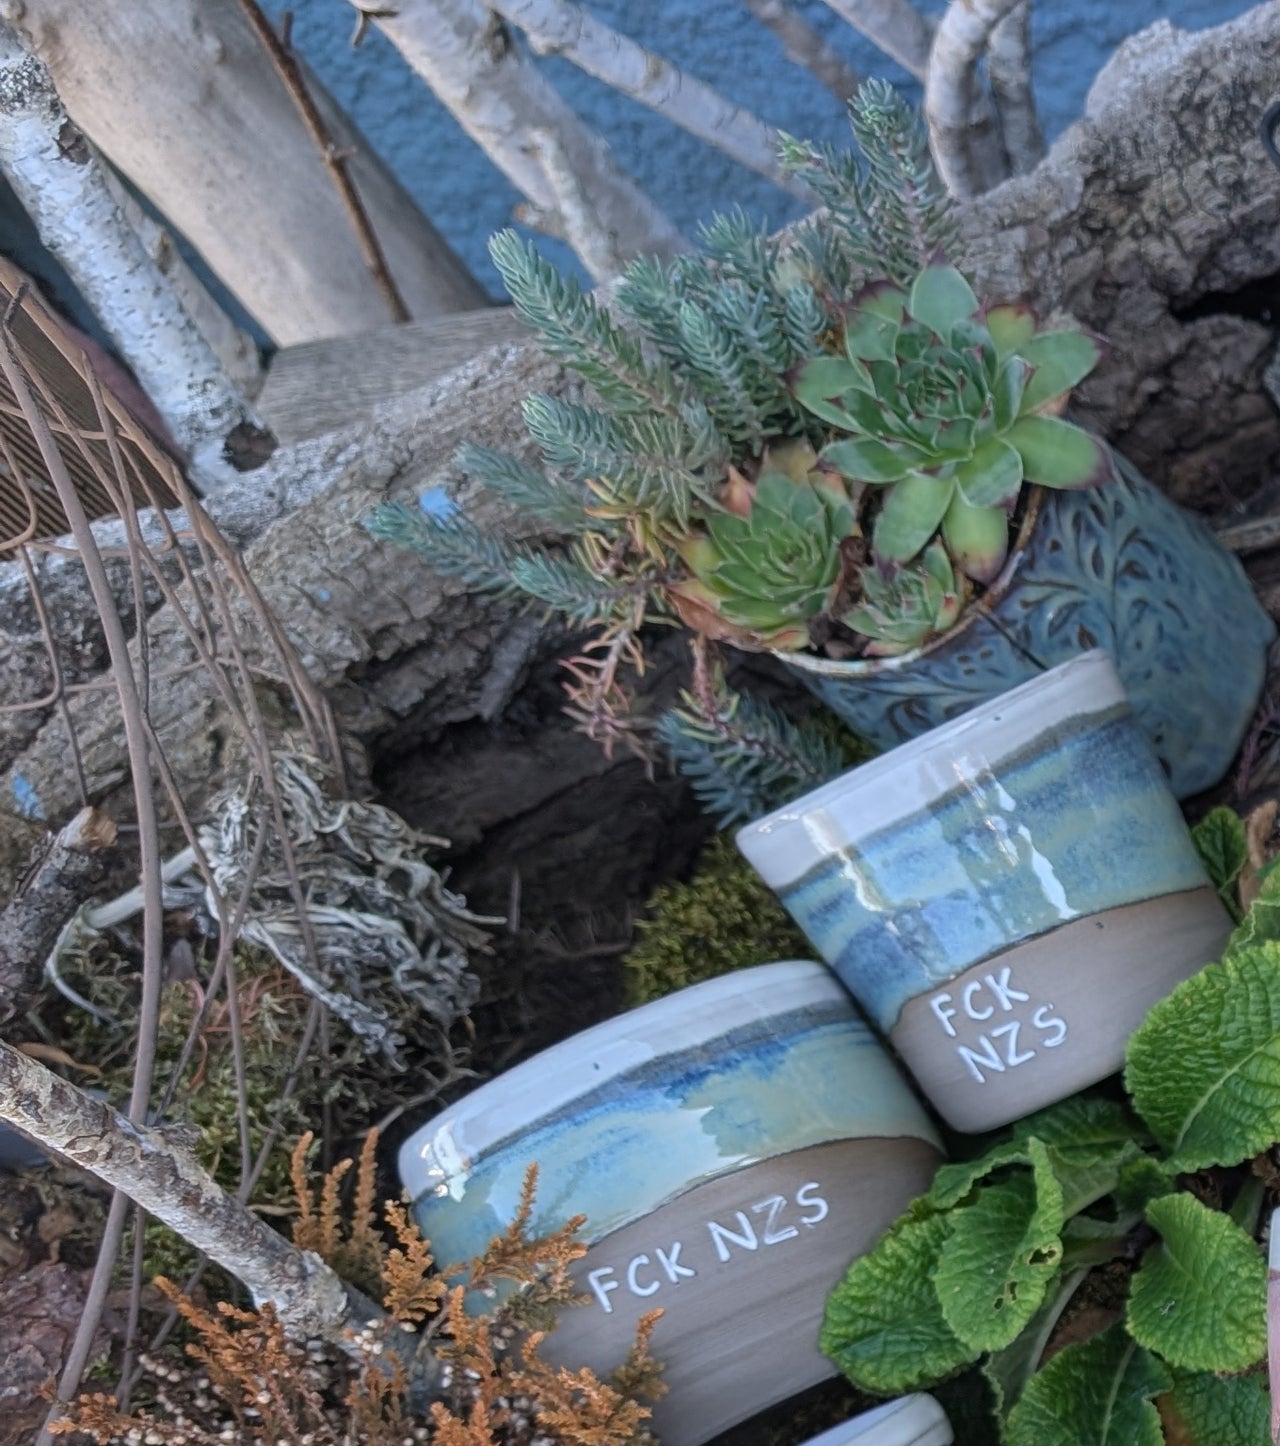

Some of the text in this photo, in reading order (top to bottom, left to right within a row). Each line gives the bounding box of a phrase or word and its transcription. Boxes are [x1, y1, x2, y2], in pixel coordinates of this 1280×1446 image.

[929, 967, 1030, 1037] FCK
[958, 1002, 1068, 1084] NZS
[587, 1181, 828, 1313] FCK NZS
